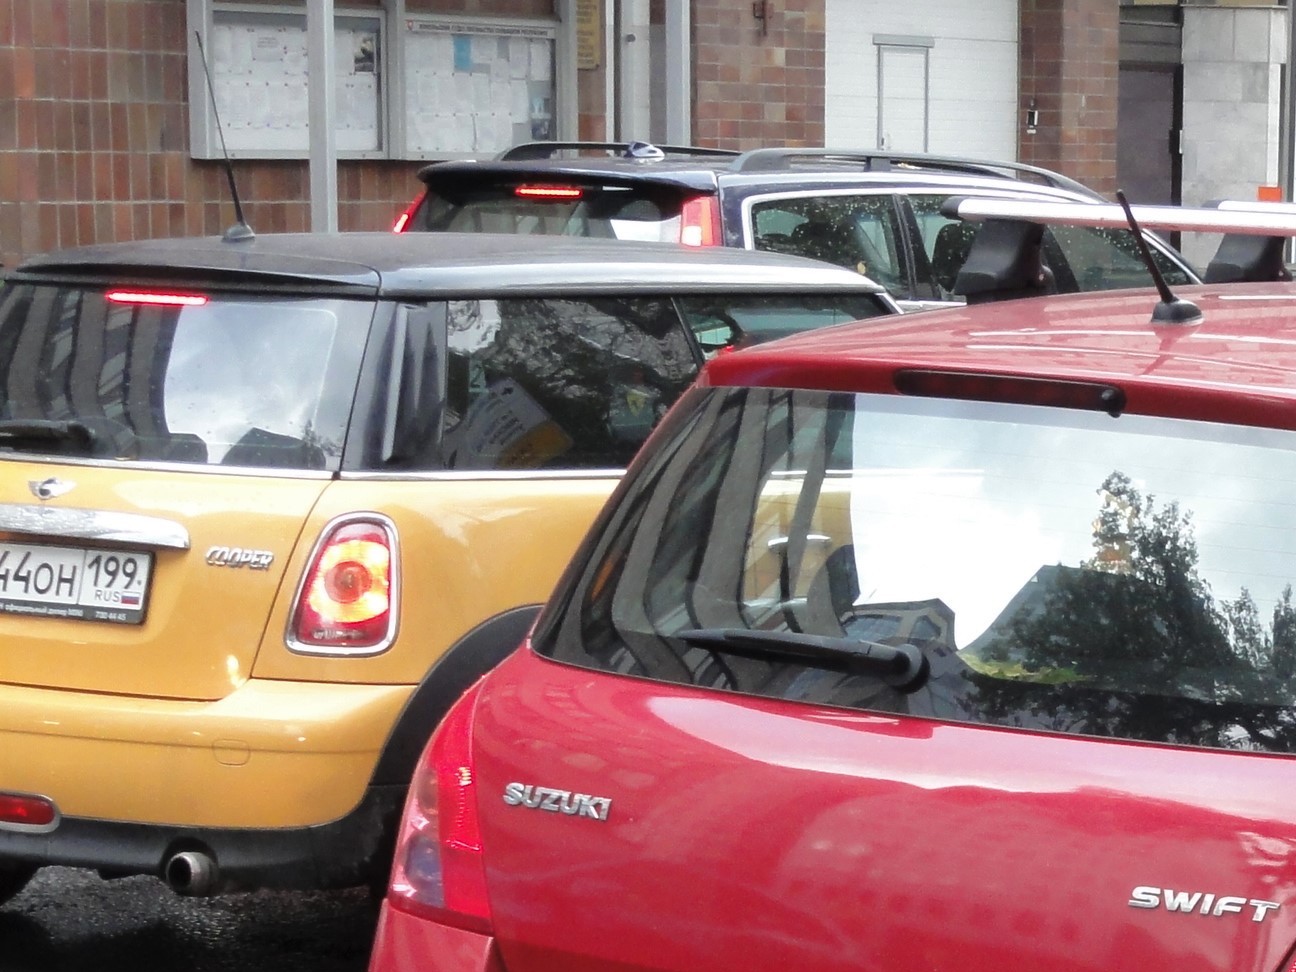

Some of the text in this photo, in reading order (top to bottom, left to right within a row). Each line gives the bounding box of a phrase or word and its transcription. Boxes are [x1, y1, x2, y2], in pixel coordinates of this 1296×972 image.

[88, 555, 138, 589] 199
[206, 546, 274, 571] COOPER
[94, 589, 120, 602] RUS
[503, 782, 612, 820] SUZUKI
[1128, 886, 1280, 922] SWIFT
